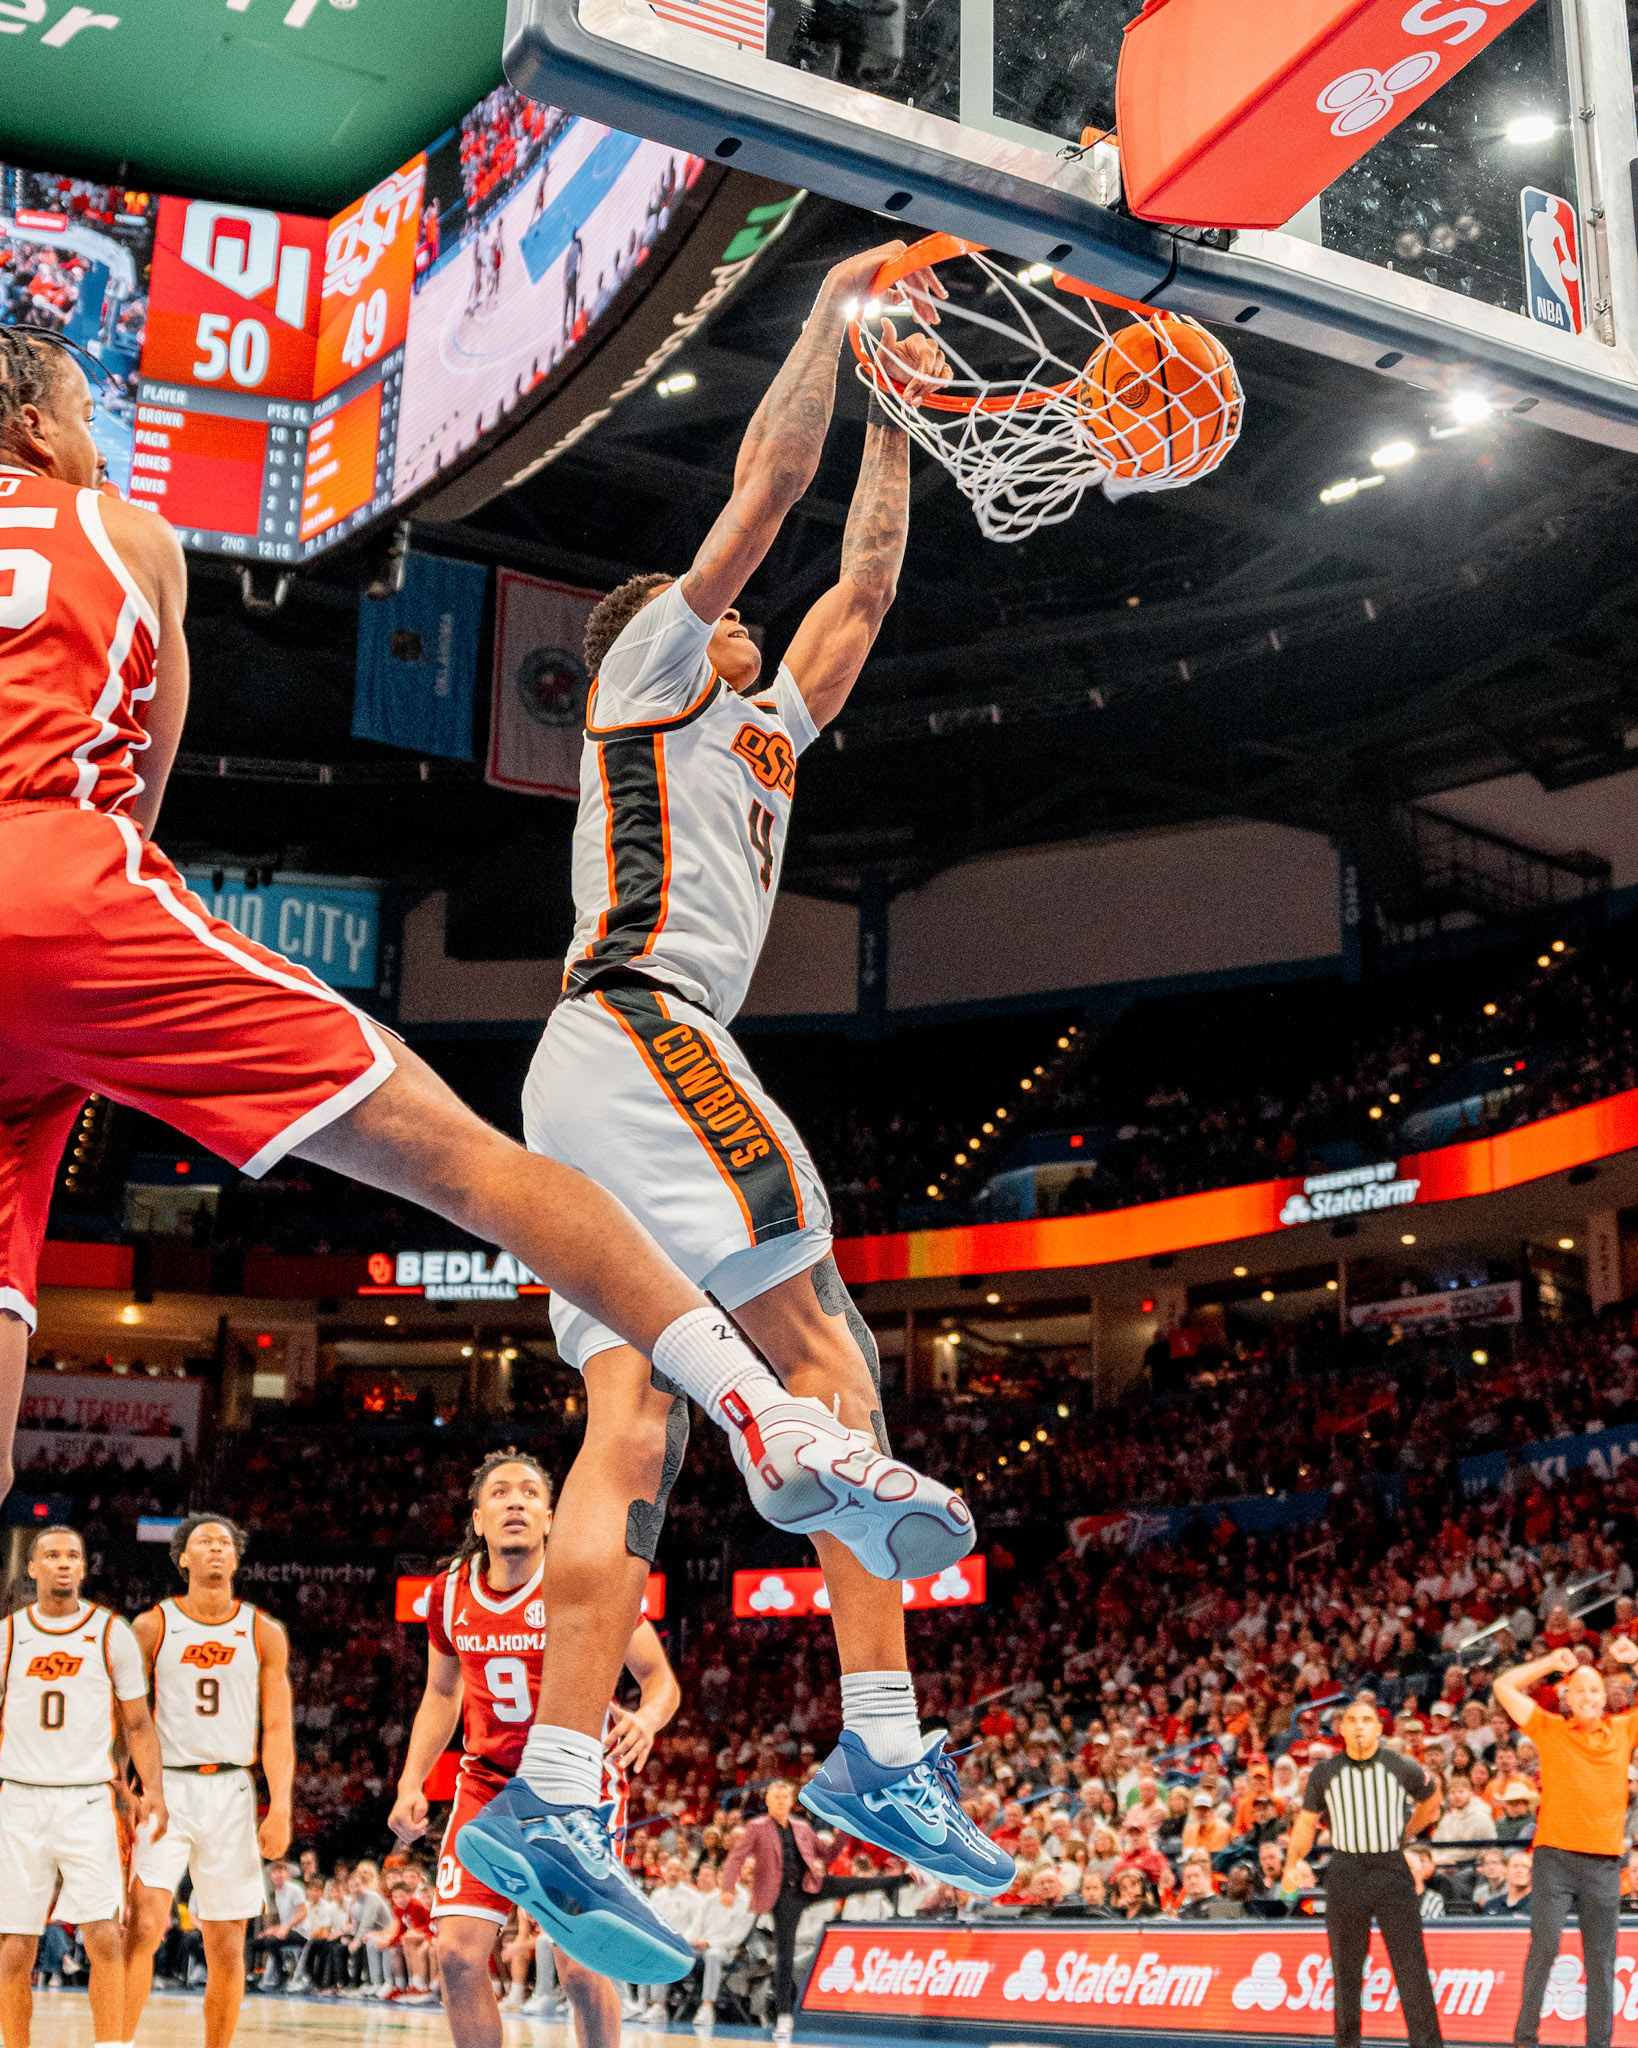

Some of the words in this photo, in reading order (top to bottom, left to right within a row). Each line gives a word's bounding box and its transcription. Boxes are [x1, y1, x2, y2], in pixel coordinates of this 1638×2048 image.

[342, 288, 387, 368] 49
[1536, 296, 1564, 326] NBA
[192, 312, 270, 387] 50
[142, 384, 188, 406] PLAYER
[267, 402, 291, 420] PTS
[293, 406, 310, 423] FL
[135, 429, 170, 449] PACK
[138, 406, 185, 429] BROWN
[271, 426, 289, 443] 10
[132, 452, 172, 473] JONES
[130, 475, 167, 495] DAVIS
[221, 535, 247, 552] 2ND
[258, 541, 293, 559] 12:15
[748, 798, 776, 893] 4
[278, 897, 368, 973] CITY
[652, 1023, 770, 1169] COWBOYS
[525, 1601, 547, 1627] SE
[195, 1678, 220, 1717] 9
[484, 1656, 533, 1722] 9
[40, 1690, 65, 1731] 0
